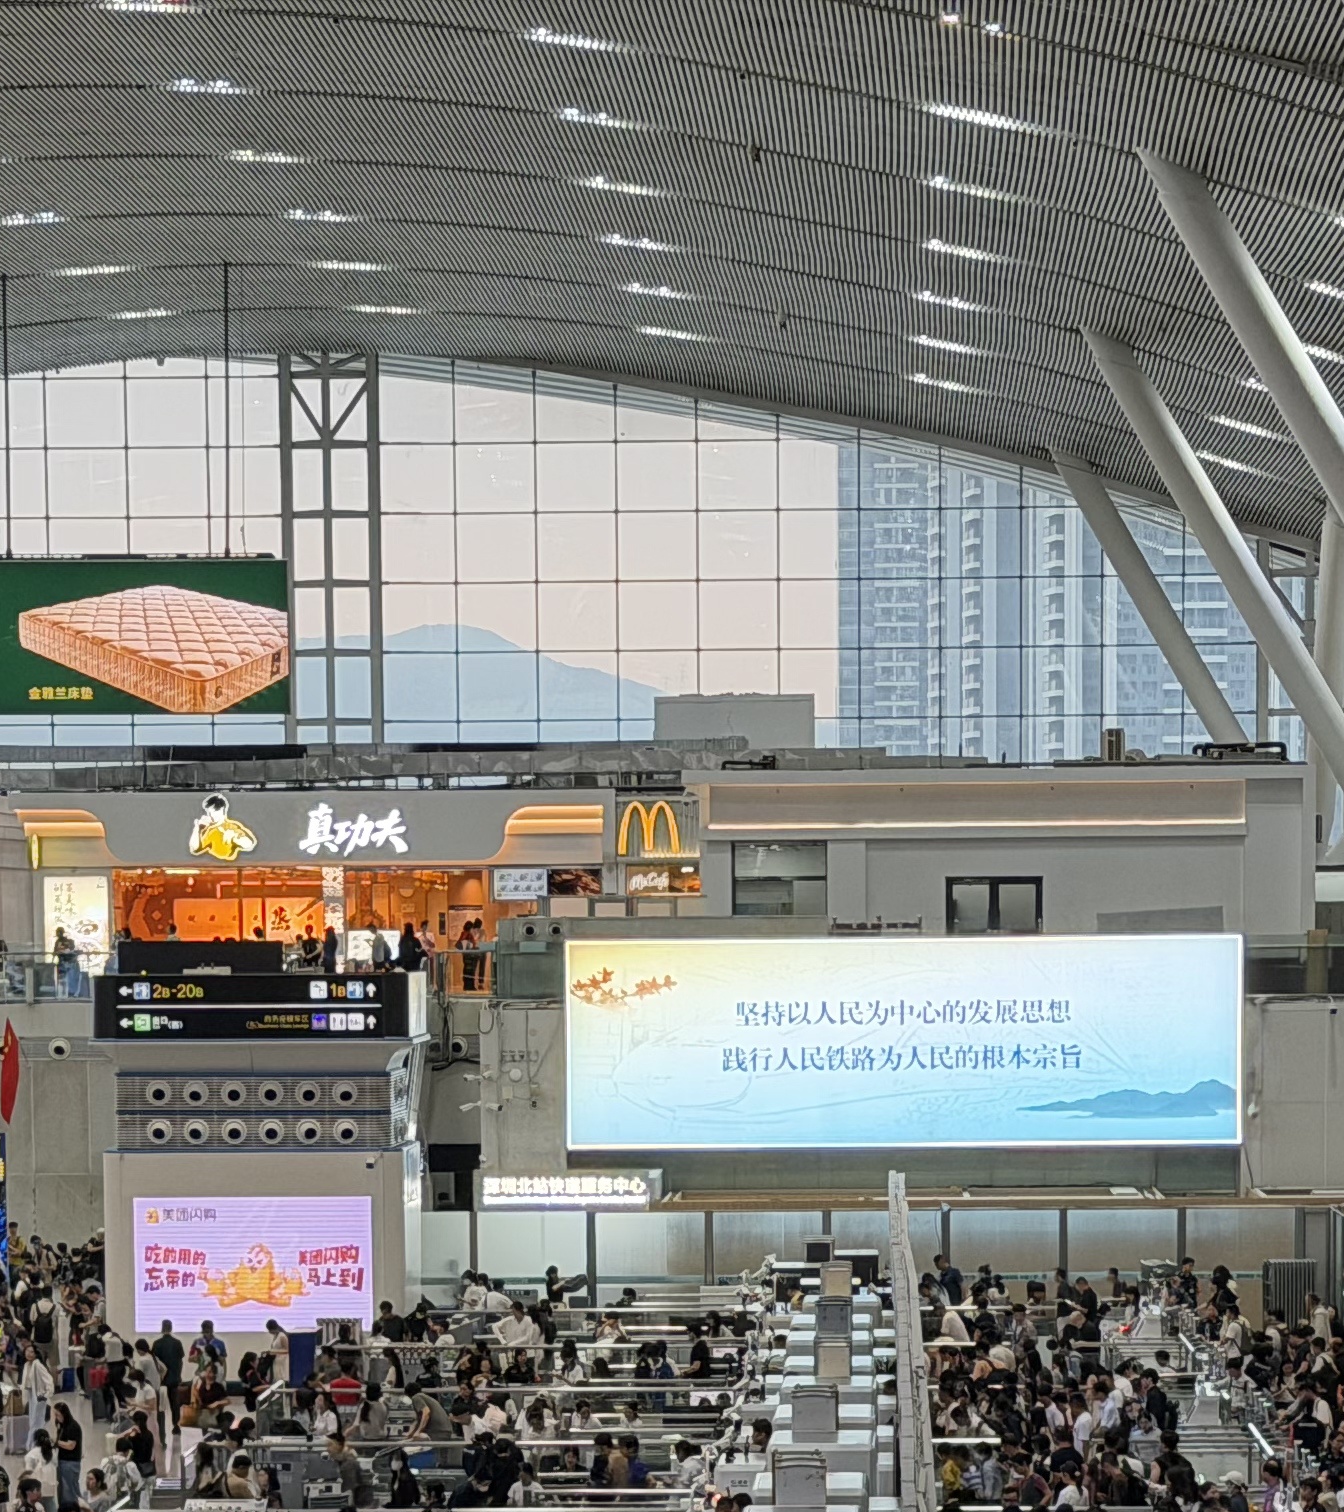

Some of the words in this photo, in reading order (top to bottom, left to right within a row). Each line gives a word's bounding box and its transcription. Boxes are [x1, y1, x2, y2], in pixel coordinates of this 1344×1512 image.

[299, 803, 409, 857] 真功夫
[735, 999, 1072, 1028] 坚持以人民为中心的发展思想
[722, 1045, 1083, 1073] 践行人民铁路为人民的根本宗旨
[162, 1208, 217, 1222] 美团闪购
[144, 1244, 206, 1265] 吃的用的
[298, 1245, 360, 1266] 美团闪购
[144, 1269, 196, 1292] 忘带的
[307, 1268, 364, 1291] 马上到
